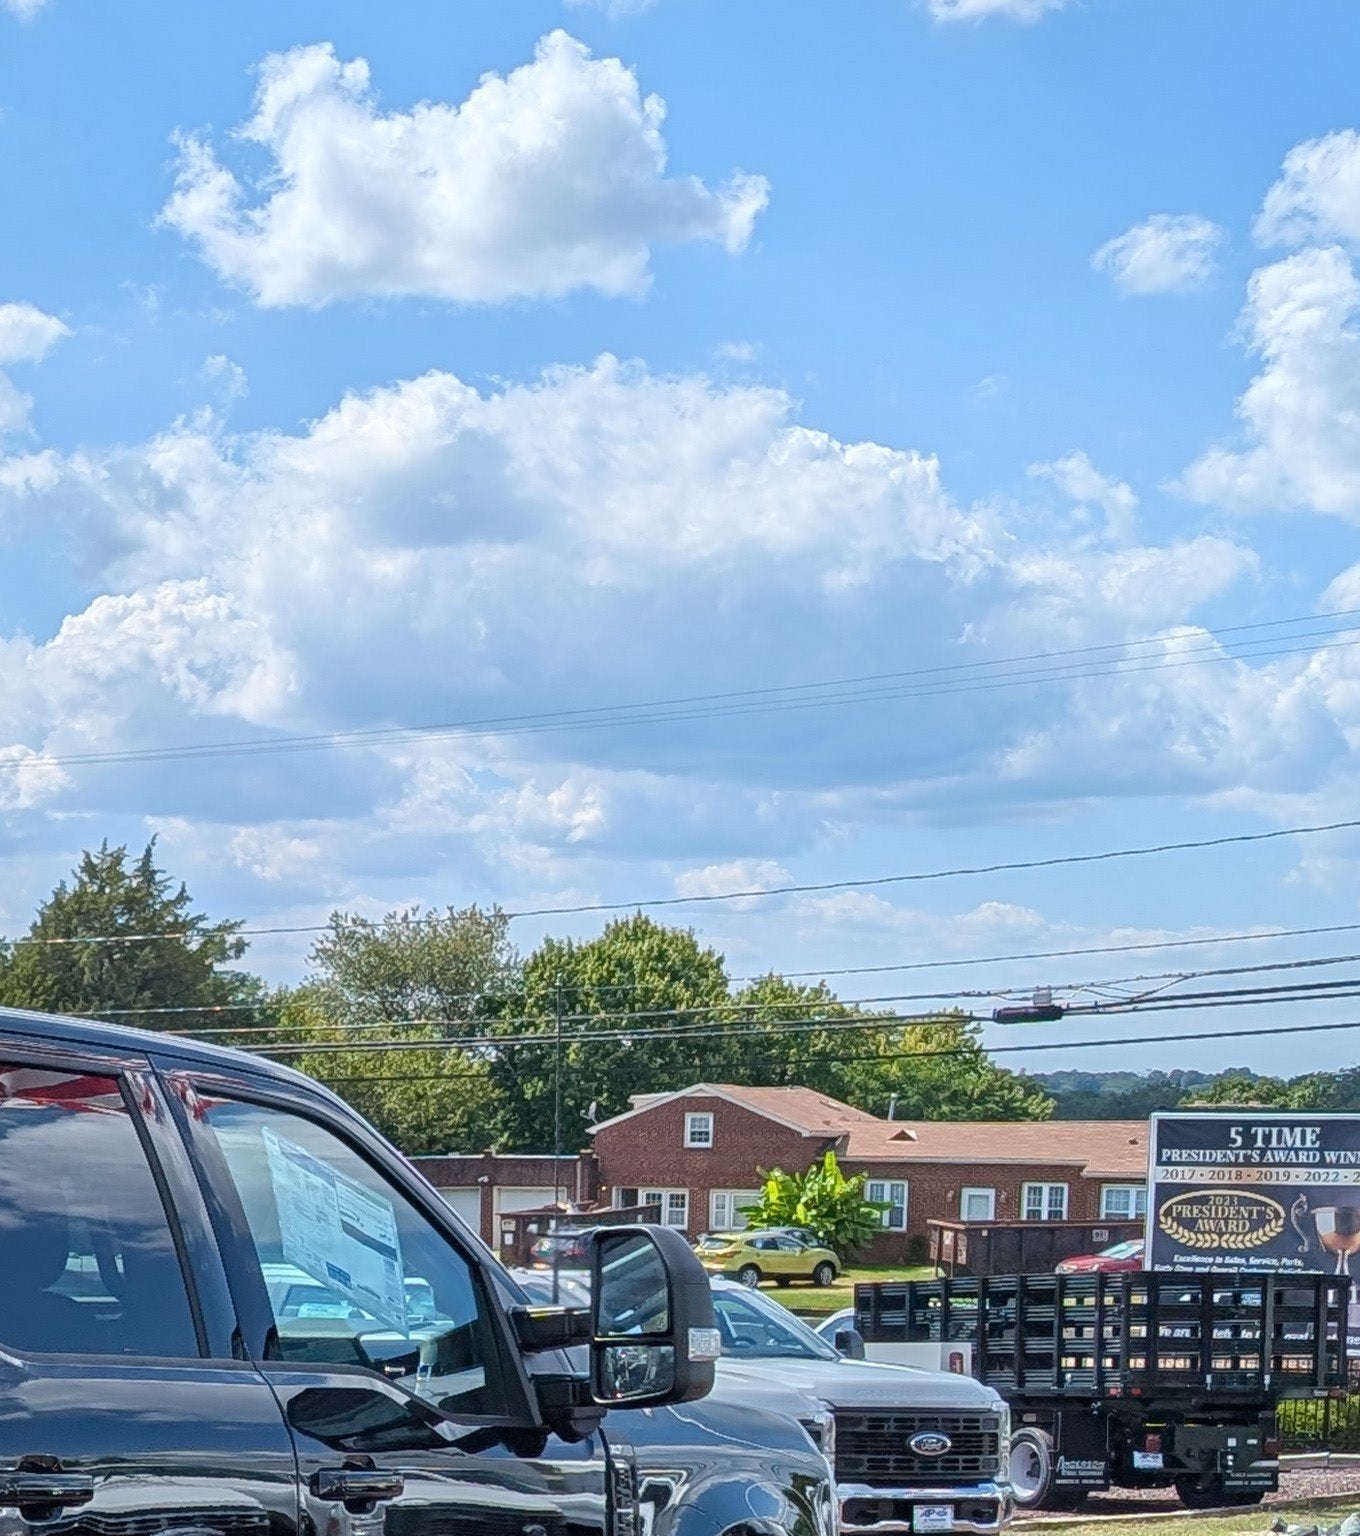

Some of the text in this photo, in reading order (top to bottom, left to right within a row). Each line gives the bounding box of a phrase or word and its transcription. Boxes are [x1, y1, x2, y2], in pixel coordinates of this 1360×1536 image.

[1228, 1127, 1321, 1148] 5 TIME
[1160, 1149, 1360, 1164] PRESIDENT'S AWARD WIN
[1162, 1169, 1196, 1181] 2017
[1208, 1170, 1243, 1181] 2018
[1256, 1170, 1291, 1182] 2019
[1304, 1171, 1340, 1183] 2022
[1208, 1196, 1239, 1206] 2023
[1172, 1205, 1275, 1219] PRESIDENT'S
[1194, 1219, 1250, 1233] AWARD
